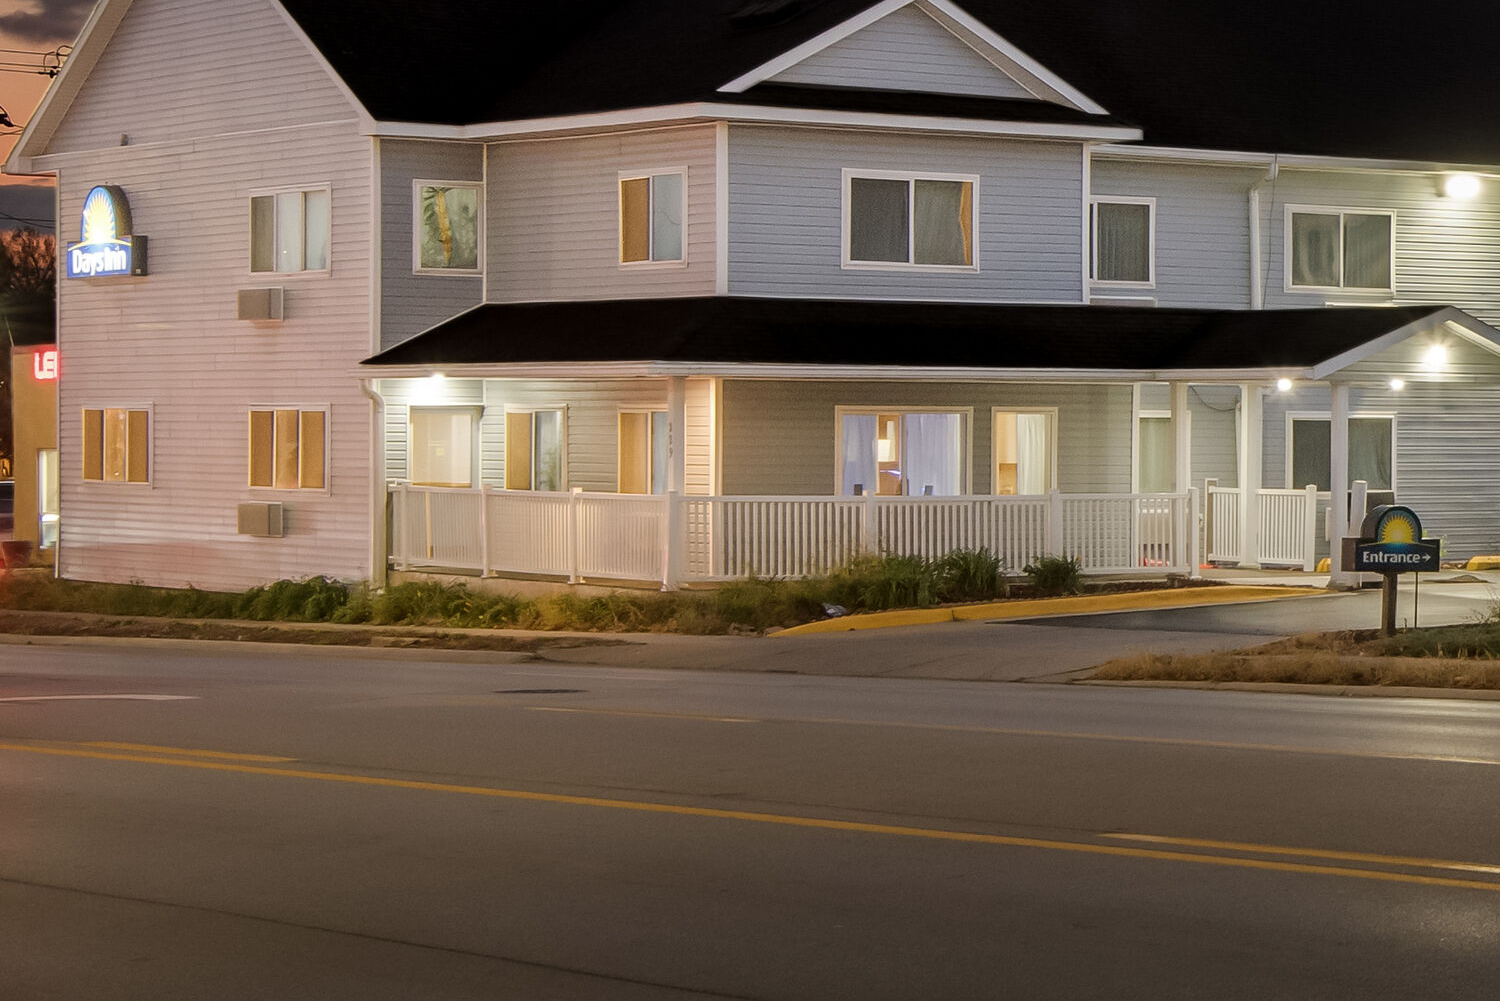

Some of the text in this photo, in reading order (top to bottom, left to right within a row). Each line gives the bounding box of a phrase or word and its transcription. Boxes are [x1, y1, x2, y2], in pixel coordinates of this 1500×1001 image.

[72, 246, 127, 276] Days Inn
[1363, 551, 1421, 563] Entrance
